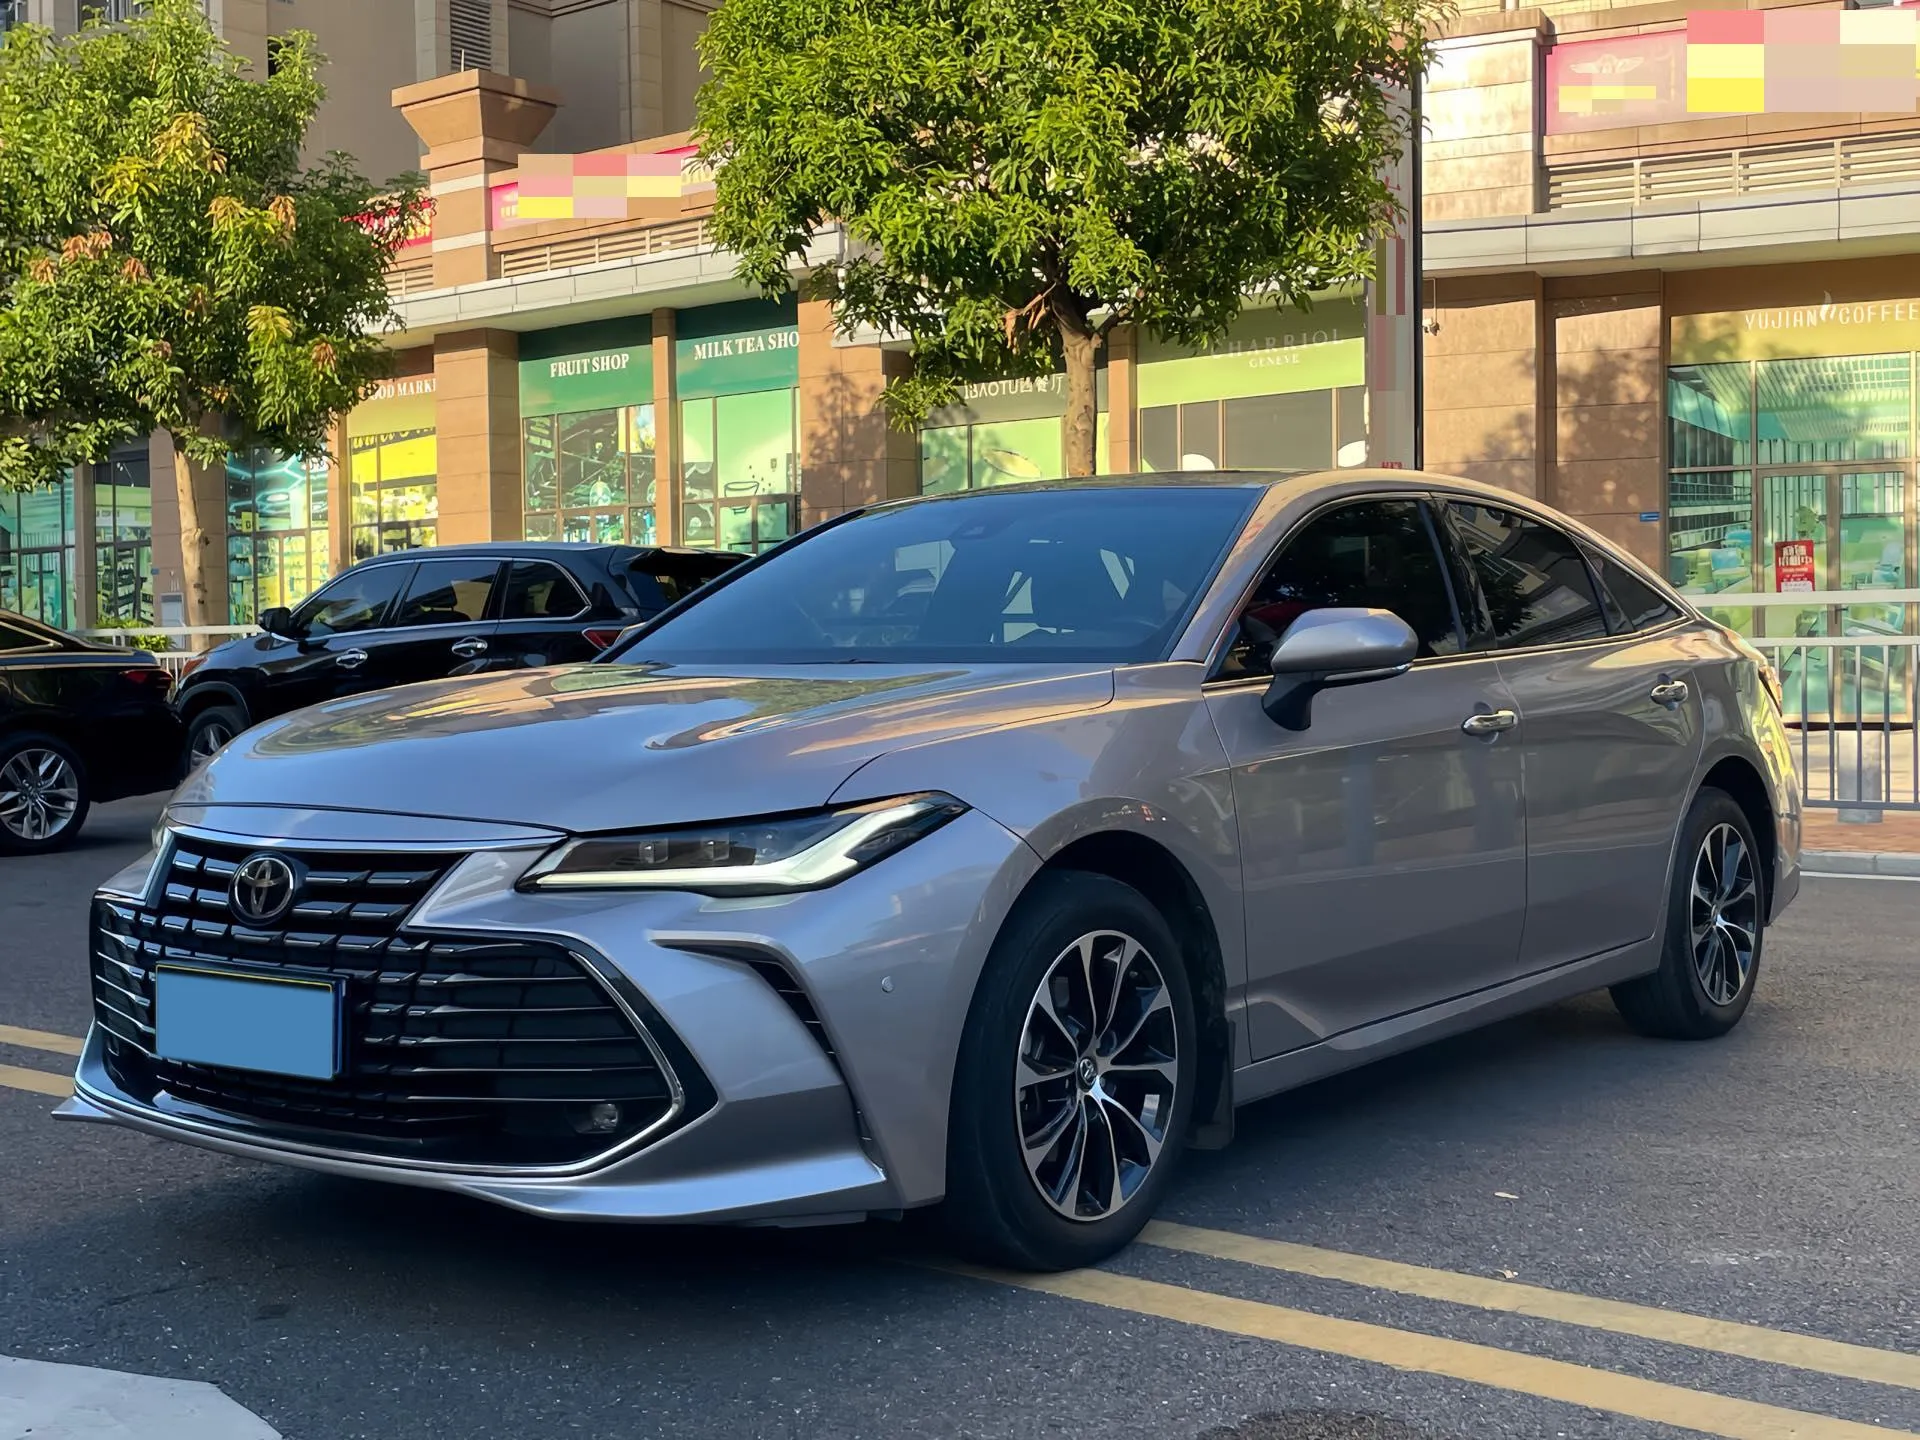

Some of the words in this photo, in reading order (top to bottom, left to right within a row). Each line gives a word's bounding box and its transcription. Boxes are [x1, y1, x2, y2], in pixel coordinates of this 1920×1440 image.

[1745, 308, 1818, 331] YUJIAN
[1838, 302, 1919, 325] COFFEE
[694, 340, 733, 361] MILK
[735, 335, 765, 355] TEA
[768, 331, 800, 350] SHO
[550, 358, 591, 378] FRUIT
[591, 353, 630, 373] SHOP
